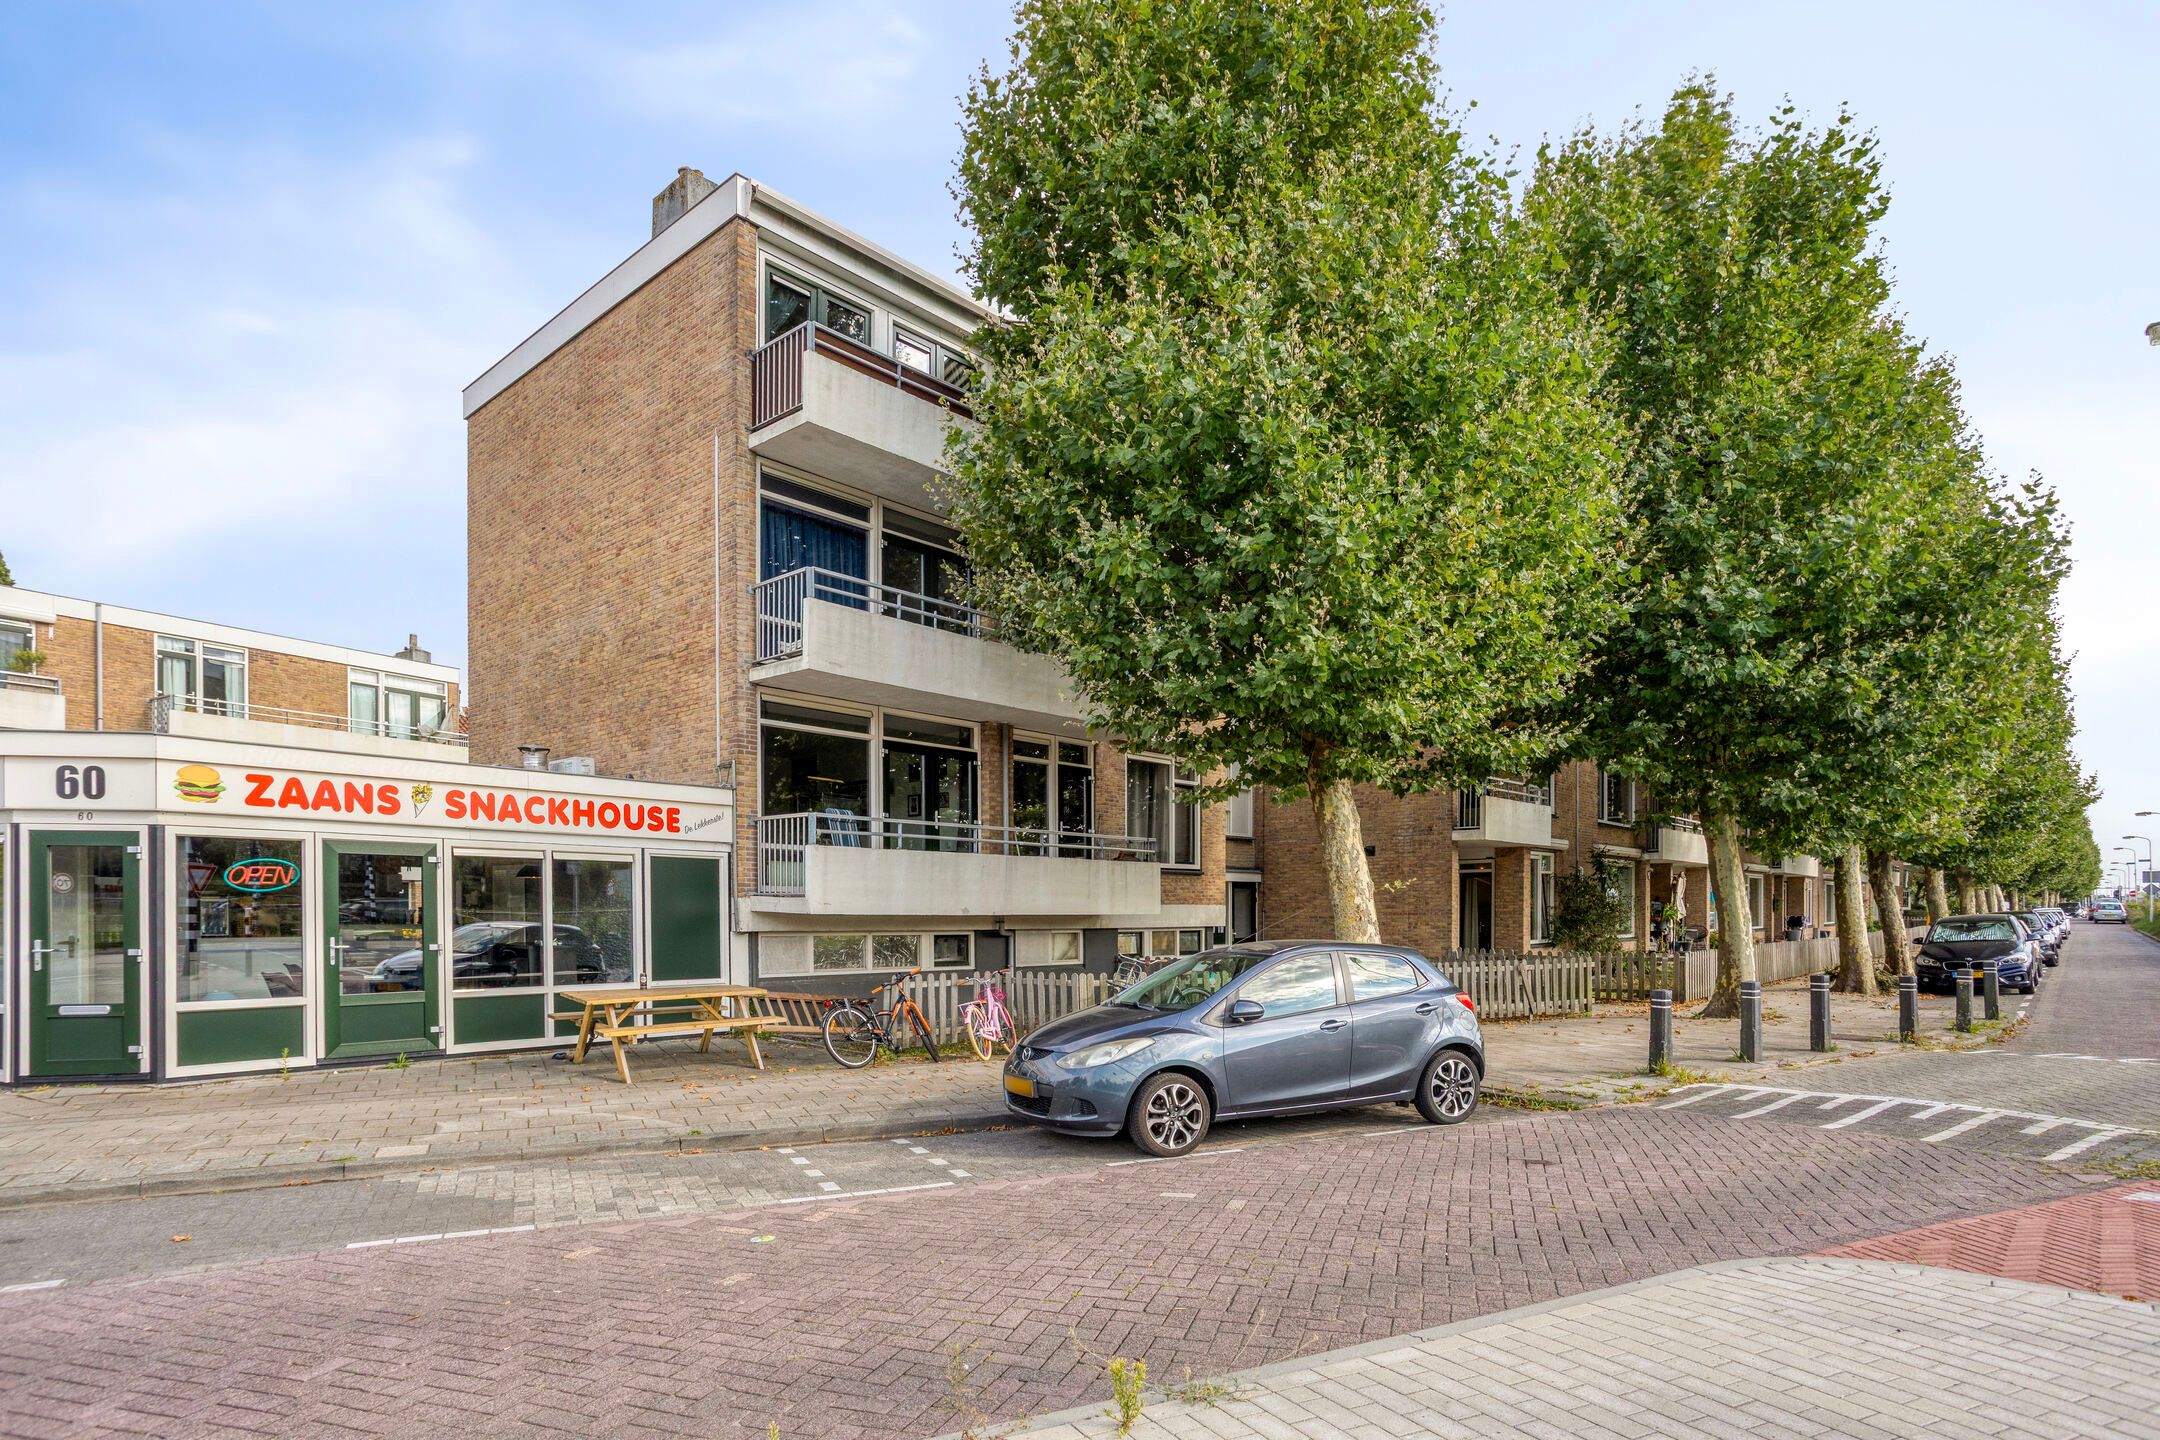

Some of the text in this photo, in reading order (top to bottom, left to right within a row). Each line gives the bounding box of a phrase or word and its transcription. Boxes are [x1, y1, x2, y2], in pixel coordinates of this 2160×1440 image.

[56, 765, 105, 799] 60
[77, 812, 94, 821] 60
[245, 774, 681, 833] ZAANS SNACKHOUSE
[228, 866, 293, 885] OPEN
